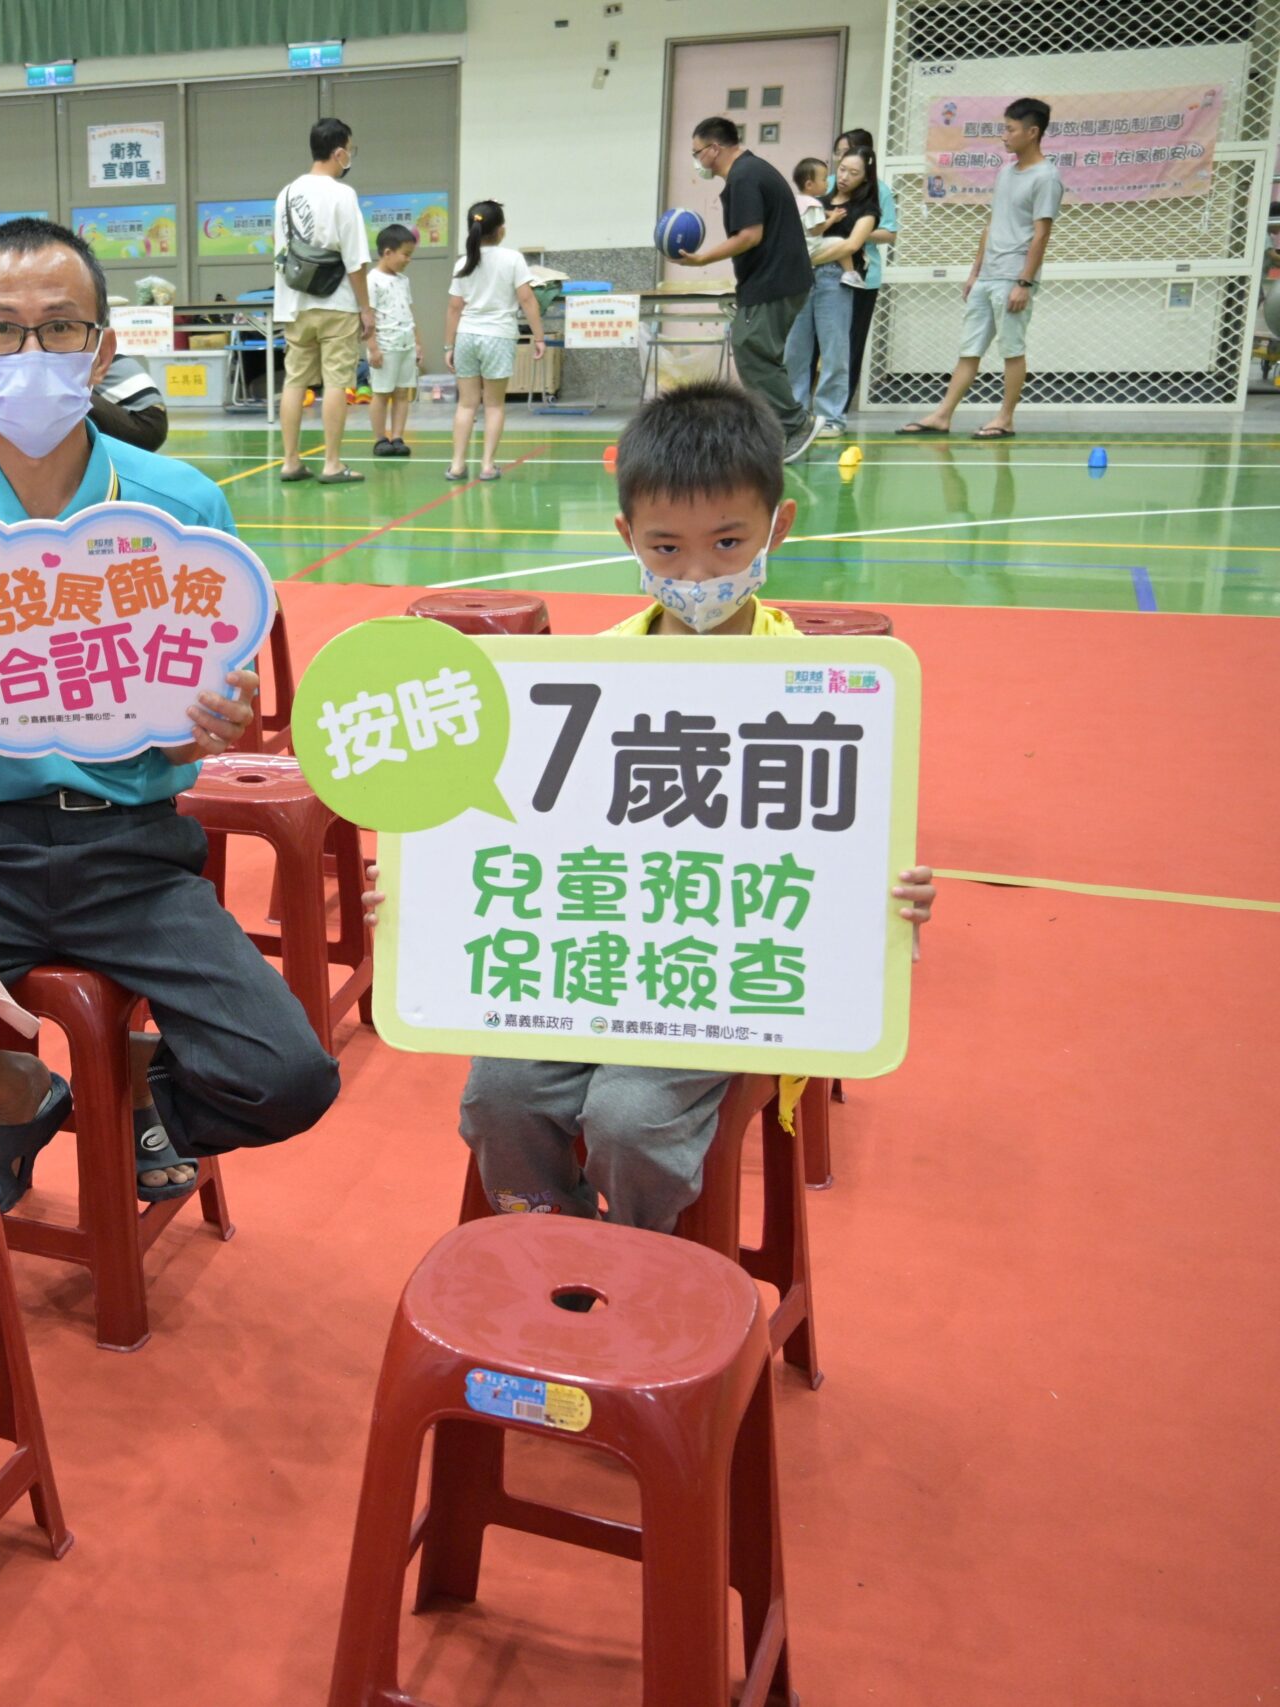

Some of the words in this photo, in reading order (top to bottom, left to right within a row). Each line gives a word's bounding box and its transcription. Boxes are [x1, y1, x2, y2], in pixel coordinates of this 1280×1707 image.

[102, 160, 151, 180] 宣導區
[111, 141, 142, 160] 衛教
[170, 374, 203, 385] 工具箱
[317, 666, 484, 779] 按時
[529, 682, 865, 832] 7歲前
[471, 845, 816, 932] 兒童預防
[464, 927, 806, 1016] 保健檢查
[504, 1013, 574, 1031] 嘉義縣政府
[763, 1032, 784, 1043] 廣告
